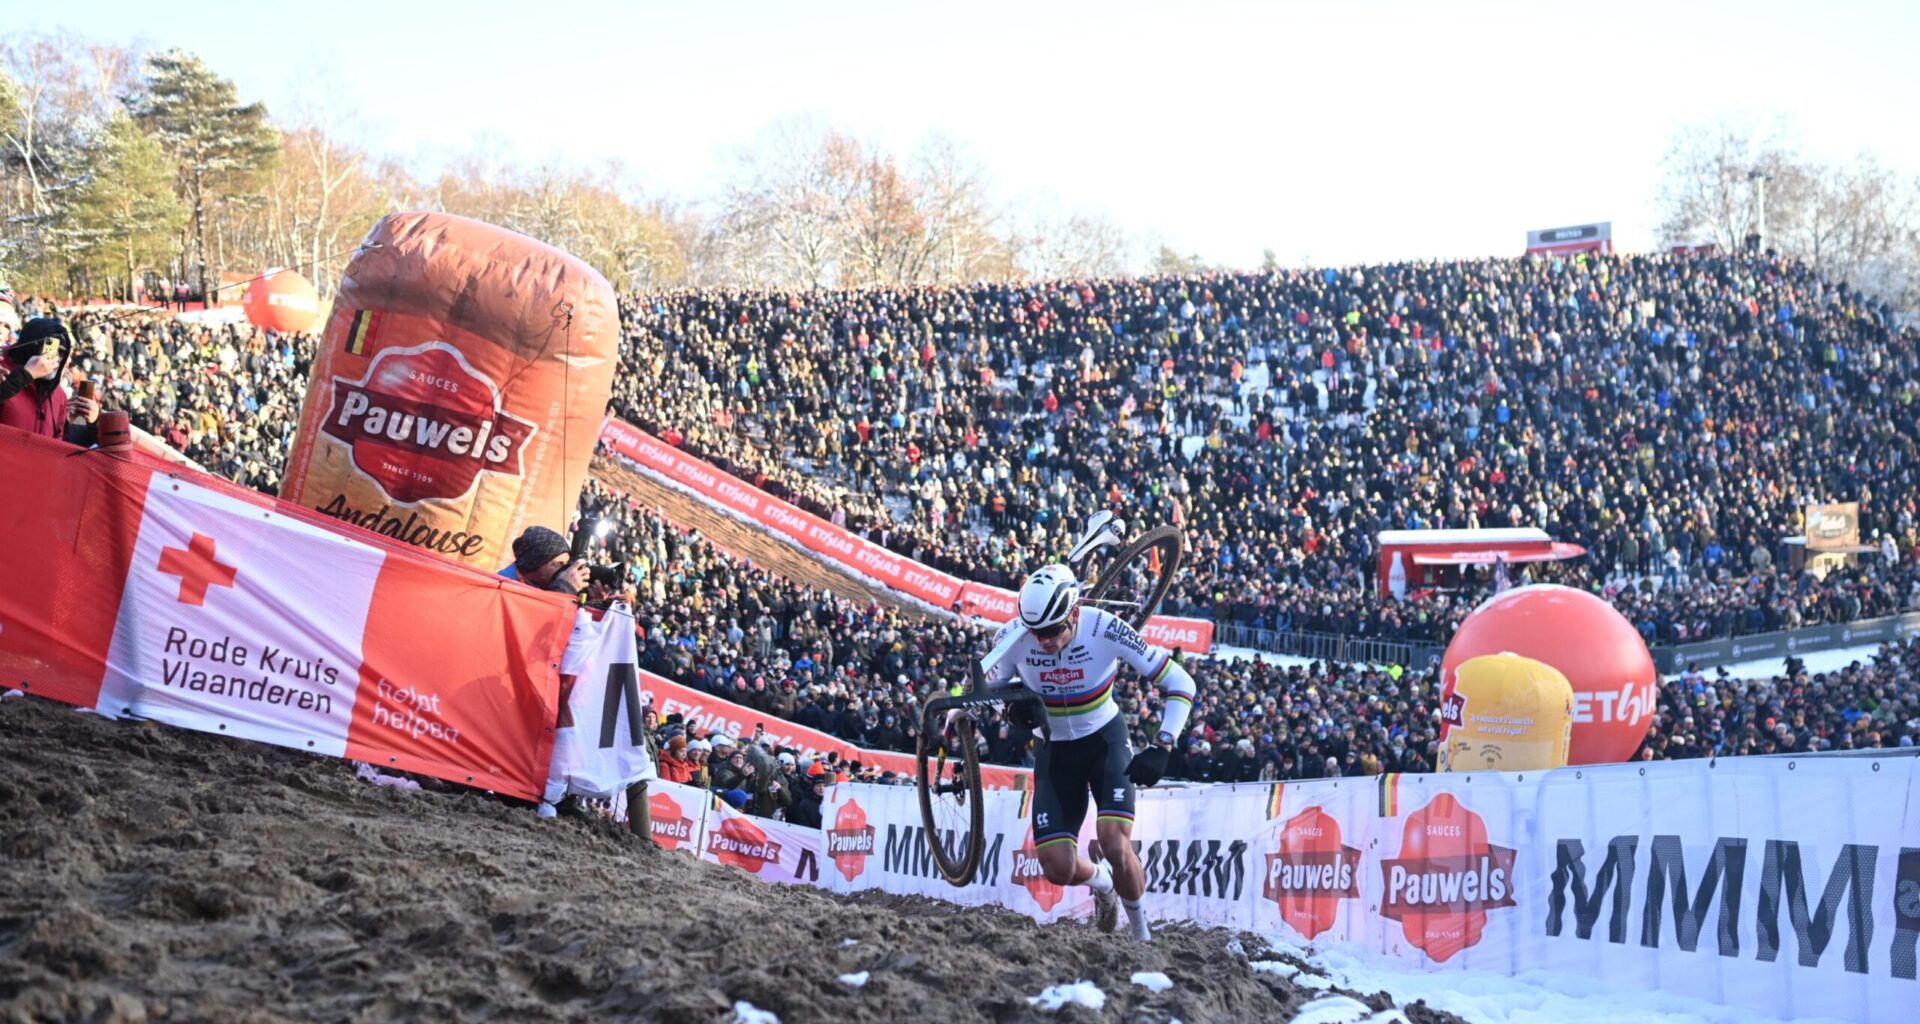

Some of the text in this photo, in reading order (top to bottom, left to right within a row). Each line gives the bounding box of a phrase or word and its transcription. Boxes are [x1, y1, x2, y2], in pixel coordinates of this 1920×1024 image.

[409, 370, 458, 393] SAUCES
[337, 391, 512, 463] Pauwels
[382, 462, 409, 476] SINCE
[315, 494, 484, 557] Andalouse
[1107, 617, 1148, 652] Alpecin
[163, 626, 340, 687] Rode Kruis
[1031, 658, 1056, 667] UCI
[161, 659, 333, 715] Vlaanderen
[1044, 671, 1080, 682] Alpecin
[375, 677, 442, 716] helpt
[370, 702, 460, 744] helpen
[711, 833, 777, 861] Pauwels
[830, 829, 872, 851] Pauwels
[1426, 824, 1461, 837] SAUCES
[1269, 853, 1351, 890] Pauwels
[1389, 856, 1506, 905] Pauwels
